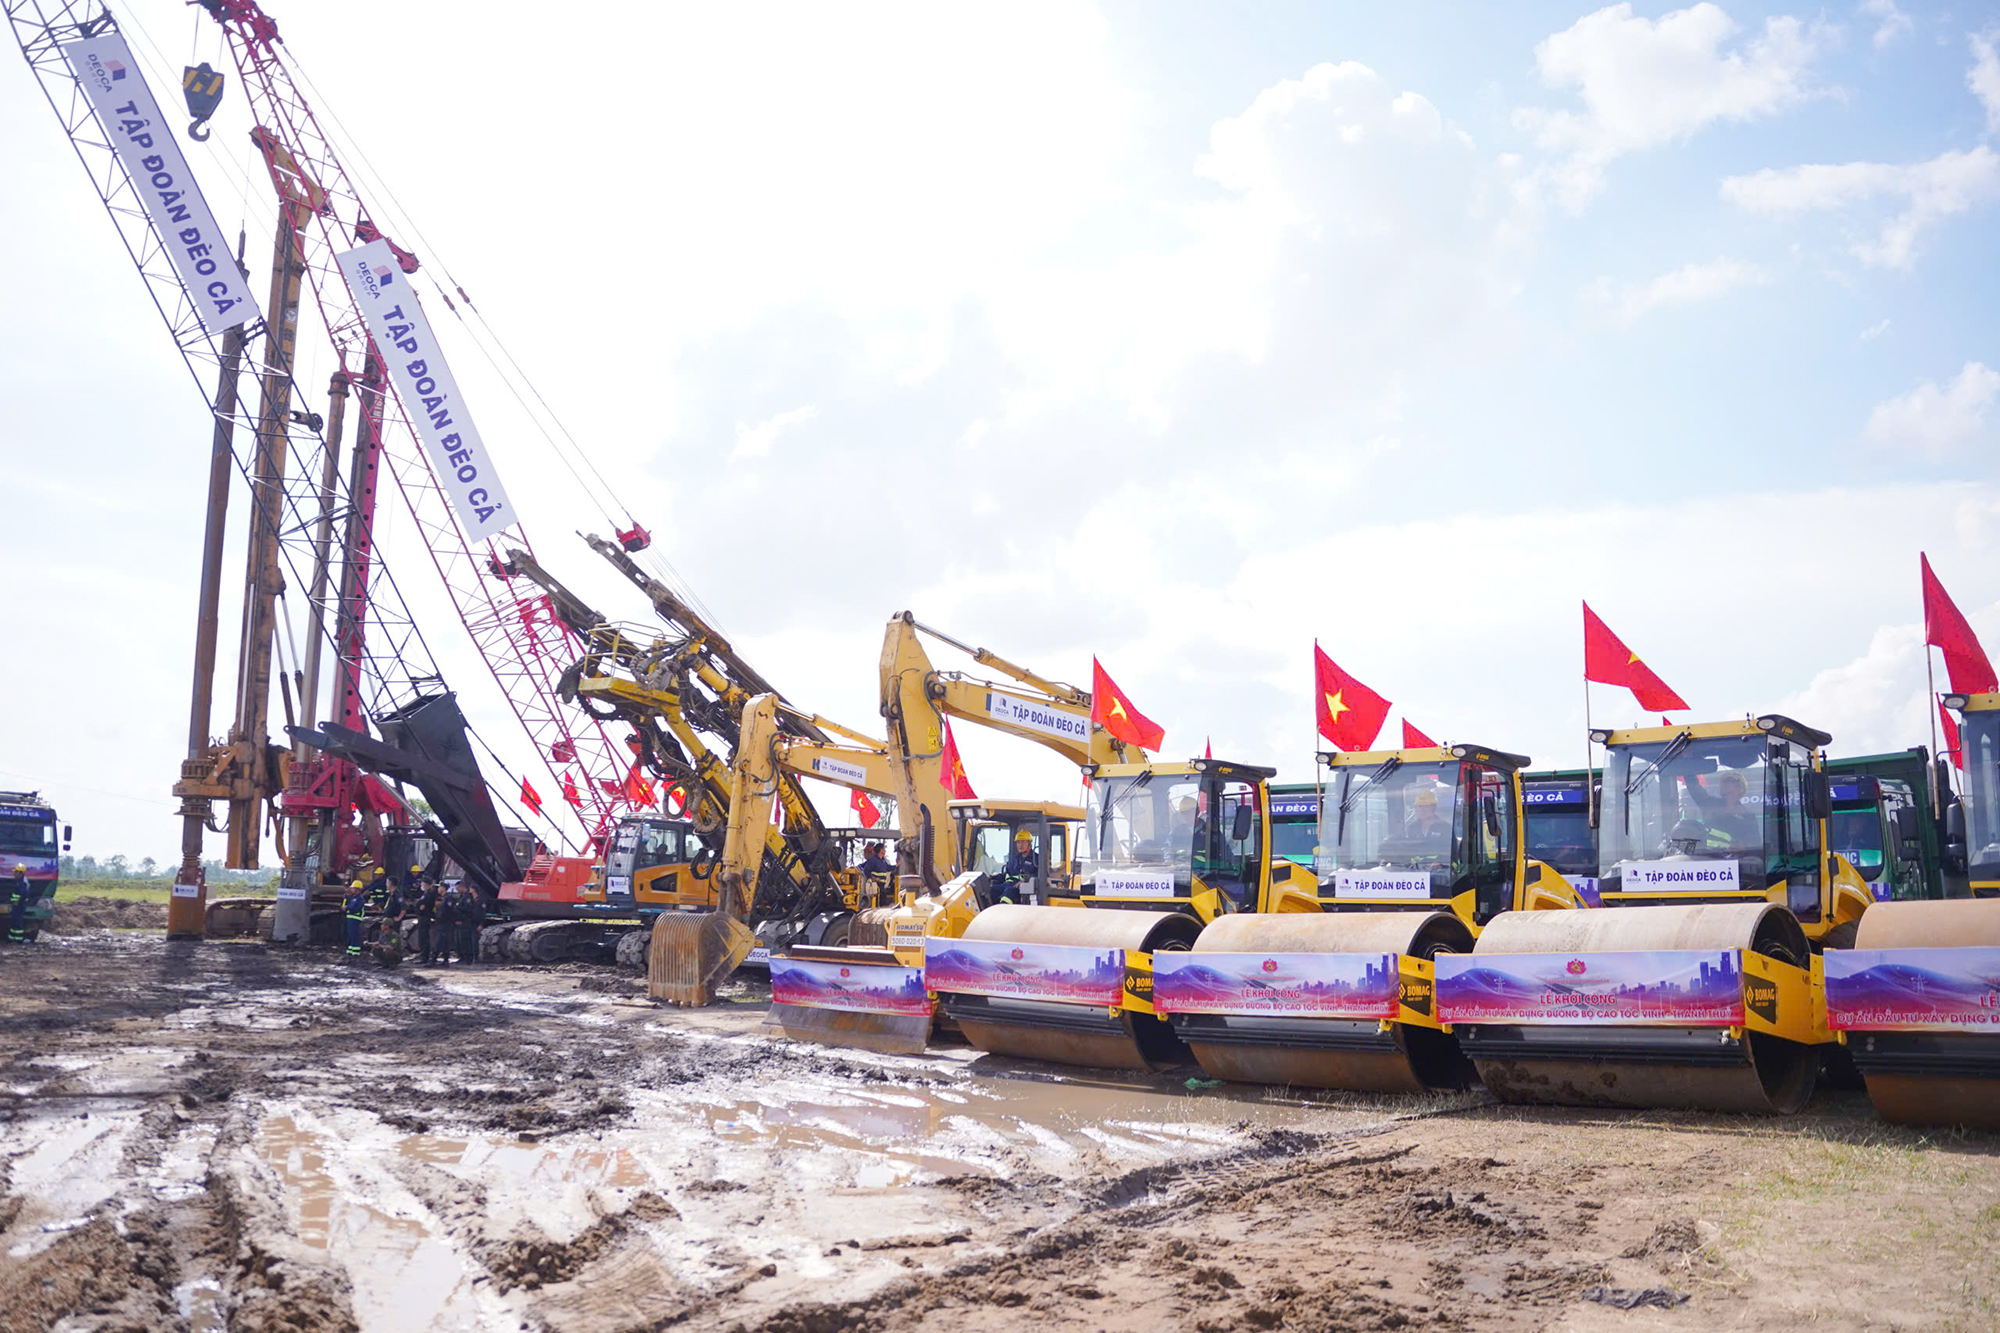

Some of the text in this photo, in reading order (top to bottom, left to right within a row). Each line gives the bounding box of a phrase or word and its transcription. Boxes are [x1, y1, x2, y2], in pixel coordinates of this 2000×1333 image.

[88, 54, 112, 93] DEOCA
[115, 100, 242, 315] TẬP ĐOÀN ĐÈO CẢ
[358, 262, 380, 300] DEOCA
[383, 304, 502, 524] TẬP ĐOÀN ĐÈO CẢ
[1013, 704, 1086, 736] TẬP ĐOÀN ĐÈO CẢ
[1546, 792, 1564, 801] CẢ
[1286, 804, 1307, 812] ĐÈO
[1645, 867, 1733, 884] TẬP ĐOÀN ĐÈO CẢ
[1112, 879, 1170, 891] TẬP ĐOÀN ĐÈO CẢ
[1355, 878, 1425, 892] TẬP ĐOÀN ĐÈO CẢ
[1136, 978, 1154, 987] BOM
[1241, 985, 1300, 999] LỄ KHỞI CÔNG
[1407, 985, 1430, 996] BOMAG
[1540, 989, 1616, 1004] LỄ KHỞI CÔNG
[1754, 988, 1774, 1001] BOMAG
[1980, 990, 1998, 1007] LỄ
[1273, 1002, 1284, 1011] BỘ
[1302, 1001, 1318, 1011] TỐC
[1320, 1003, 1338, 1011] VINH
[1520, 1009, 1544, 1019] DỰNG
[1547, 1008, 1579, 1018] ĐƯỜNG
[1581, 1009, 1594, 1020] BỘ
[1596, 1010, 1617, 1018] CAO
[1620, 1006, 1639, 1018] TỐC
[1642, 1010, 1664, 1018] VINH
[1673, 1008, 1706, 1019] THANH
[1837, 1012, 1854, 1025] DỰ
[1856, 1010, 1873, 1023] ÁN
[1876, 1008, 1901, 1023] ĐẦU
[1906, 1012, 1919, 1023] TƯ
[1922, 1011, 1947, 1023] XÂY
[1950, 1014, 1986, 1026] DỰNG
